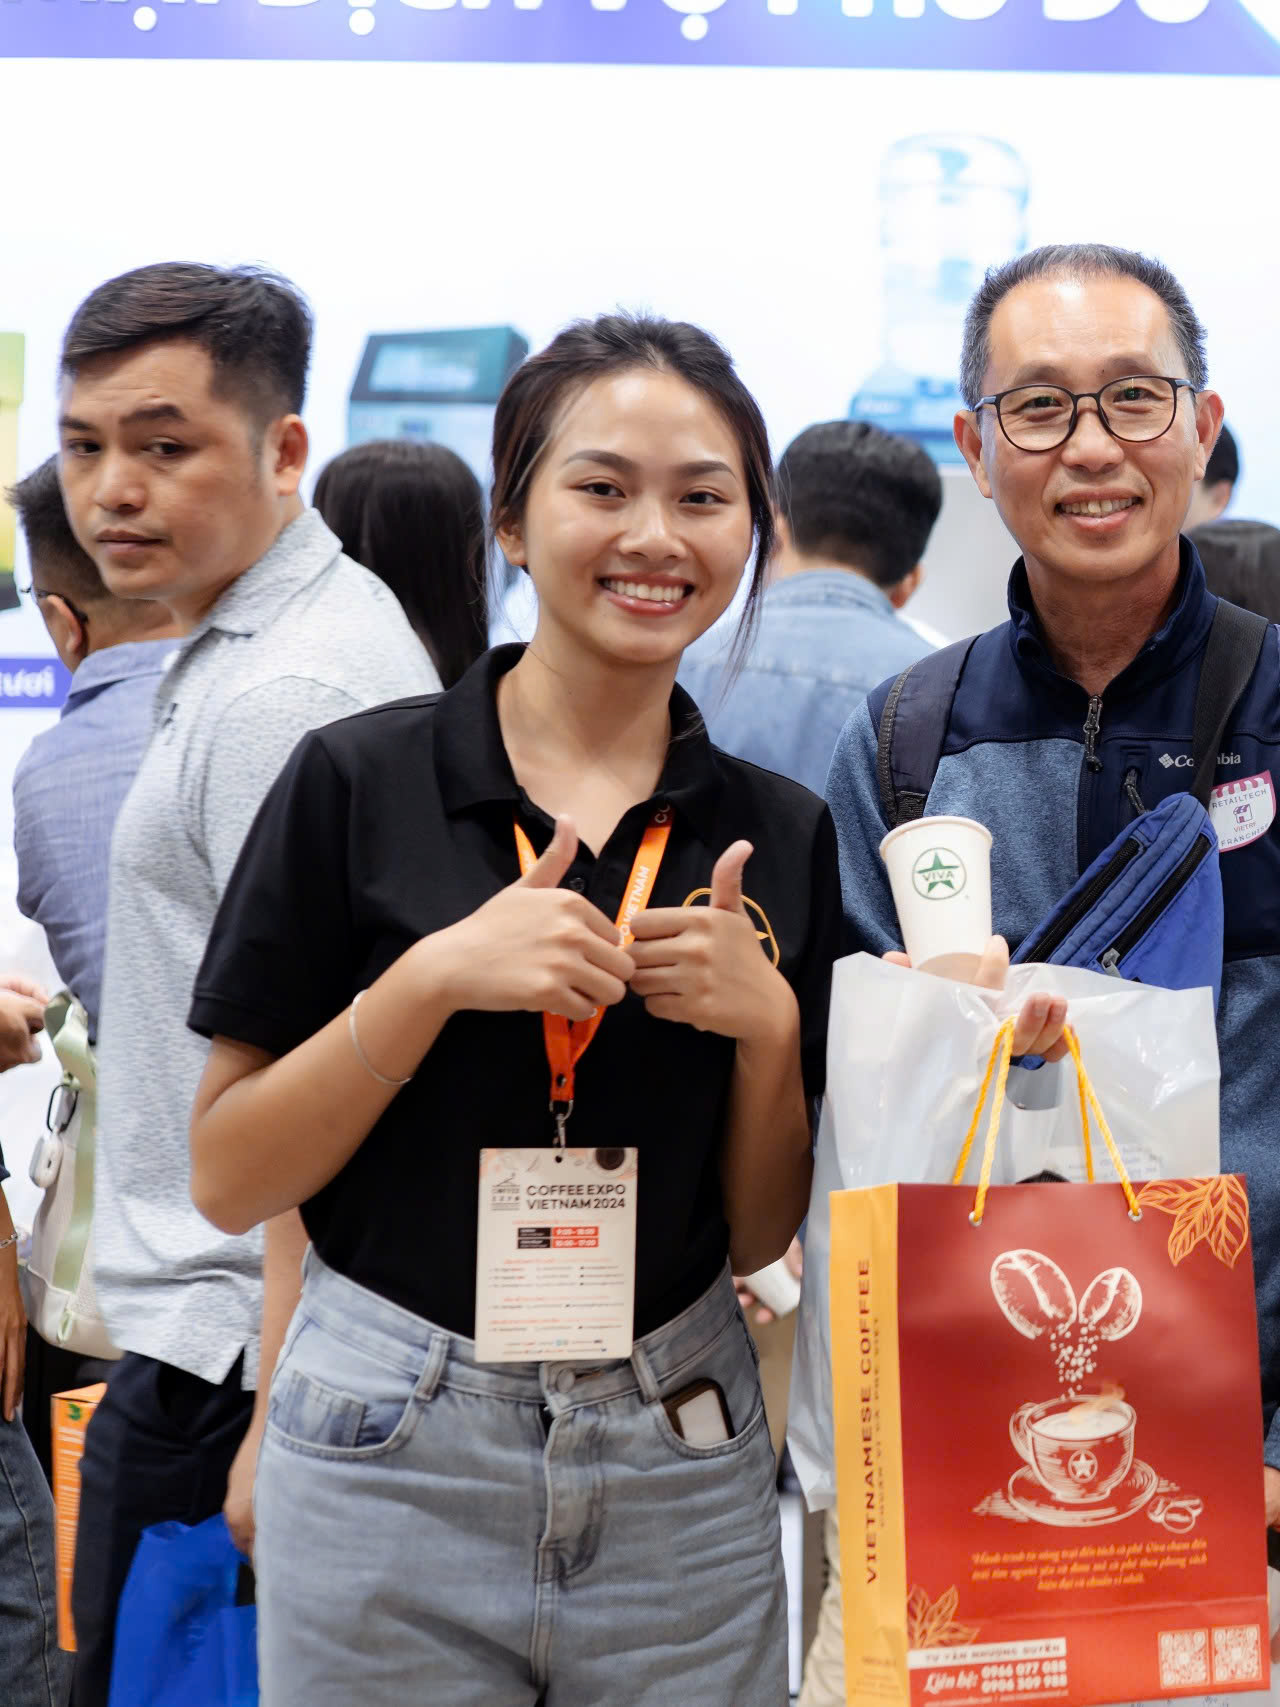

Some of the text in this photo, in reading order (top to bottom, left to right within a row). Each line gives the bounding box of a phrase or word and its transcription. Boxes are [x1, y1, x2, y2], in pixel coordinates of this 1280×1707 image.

[1211, 788, 1267, 809] RETAILTECH
[922, 870, 955, 882] VIVA
[526, 1184, 626, 1196] COFFEE EXPO
[527, 1198, 626, 1210] VIETNAM 2024
[858, 1259, 878, 1585] VIETNAMESE COFFEE
